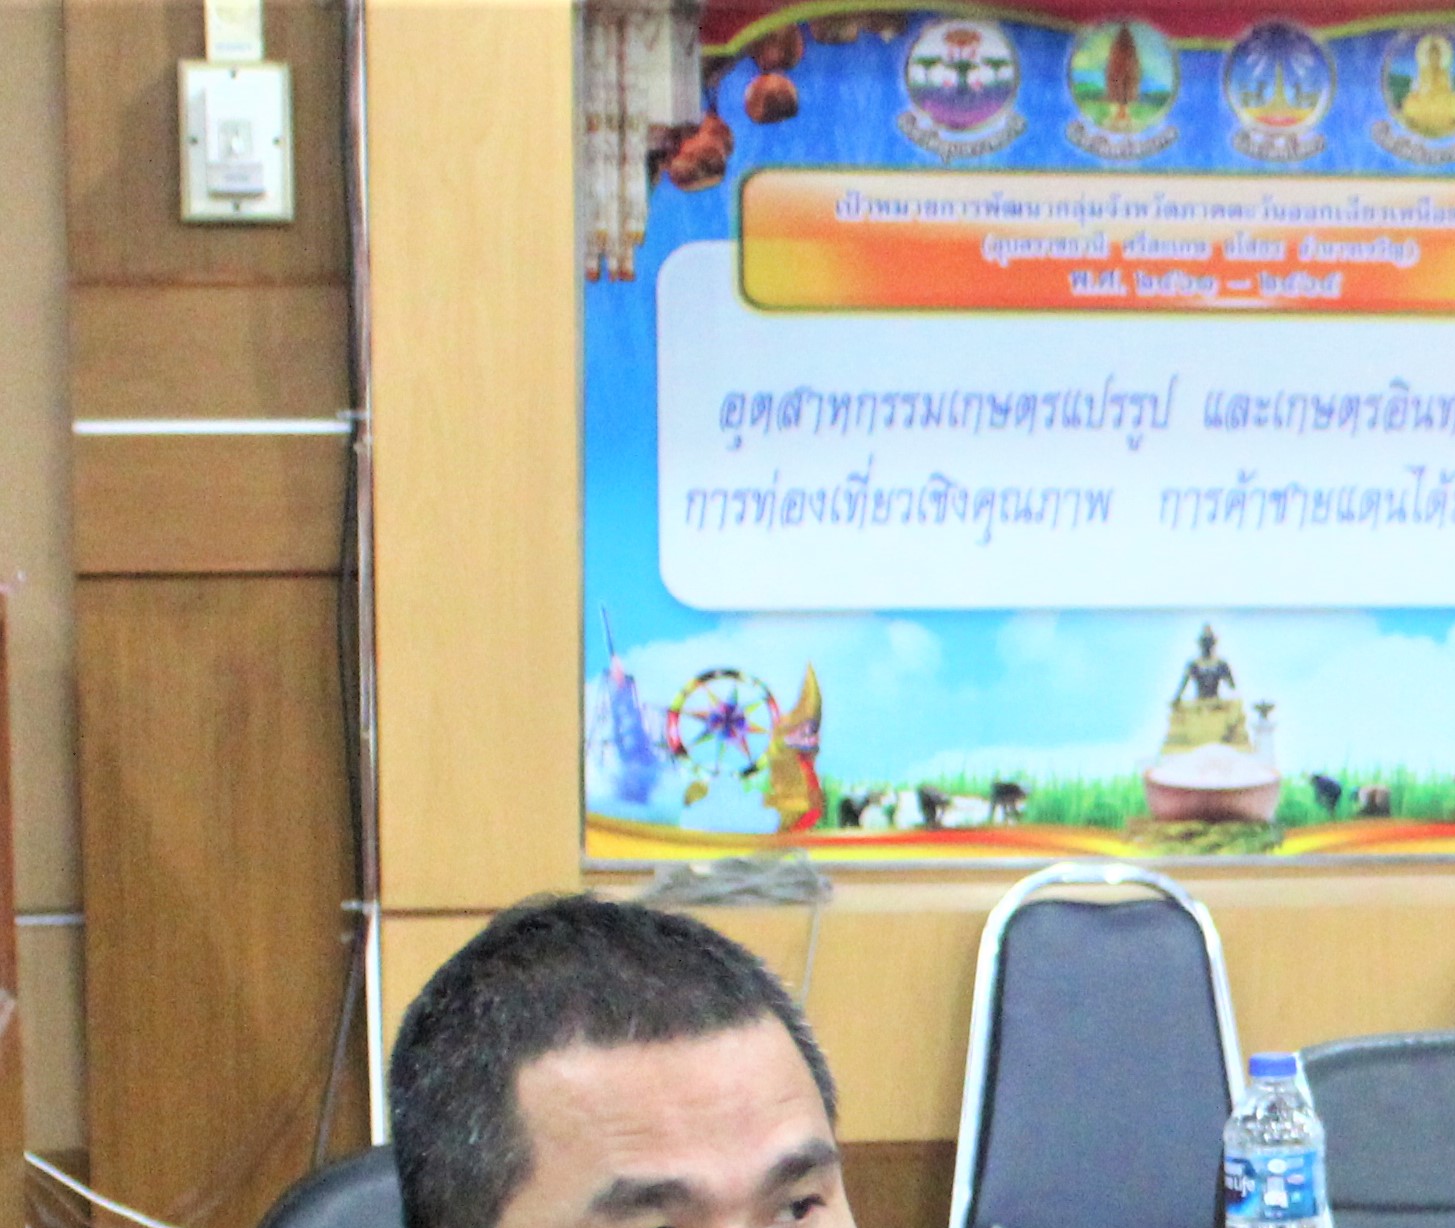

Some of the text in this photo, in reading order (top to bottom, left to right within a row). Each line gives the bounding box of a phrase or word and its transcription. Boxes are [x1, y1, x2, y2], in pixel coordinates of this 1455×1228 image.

[719, 373, 1177, 450] อุตสาหกรรมเกษตรแปรรูป
[685, 454, 1113, 546] การท่องเที่ยวเชิงคุณภาพ
